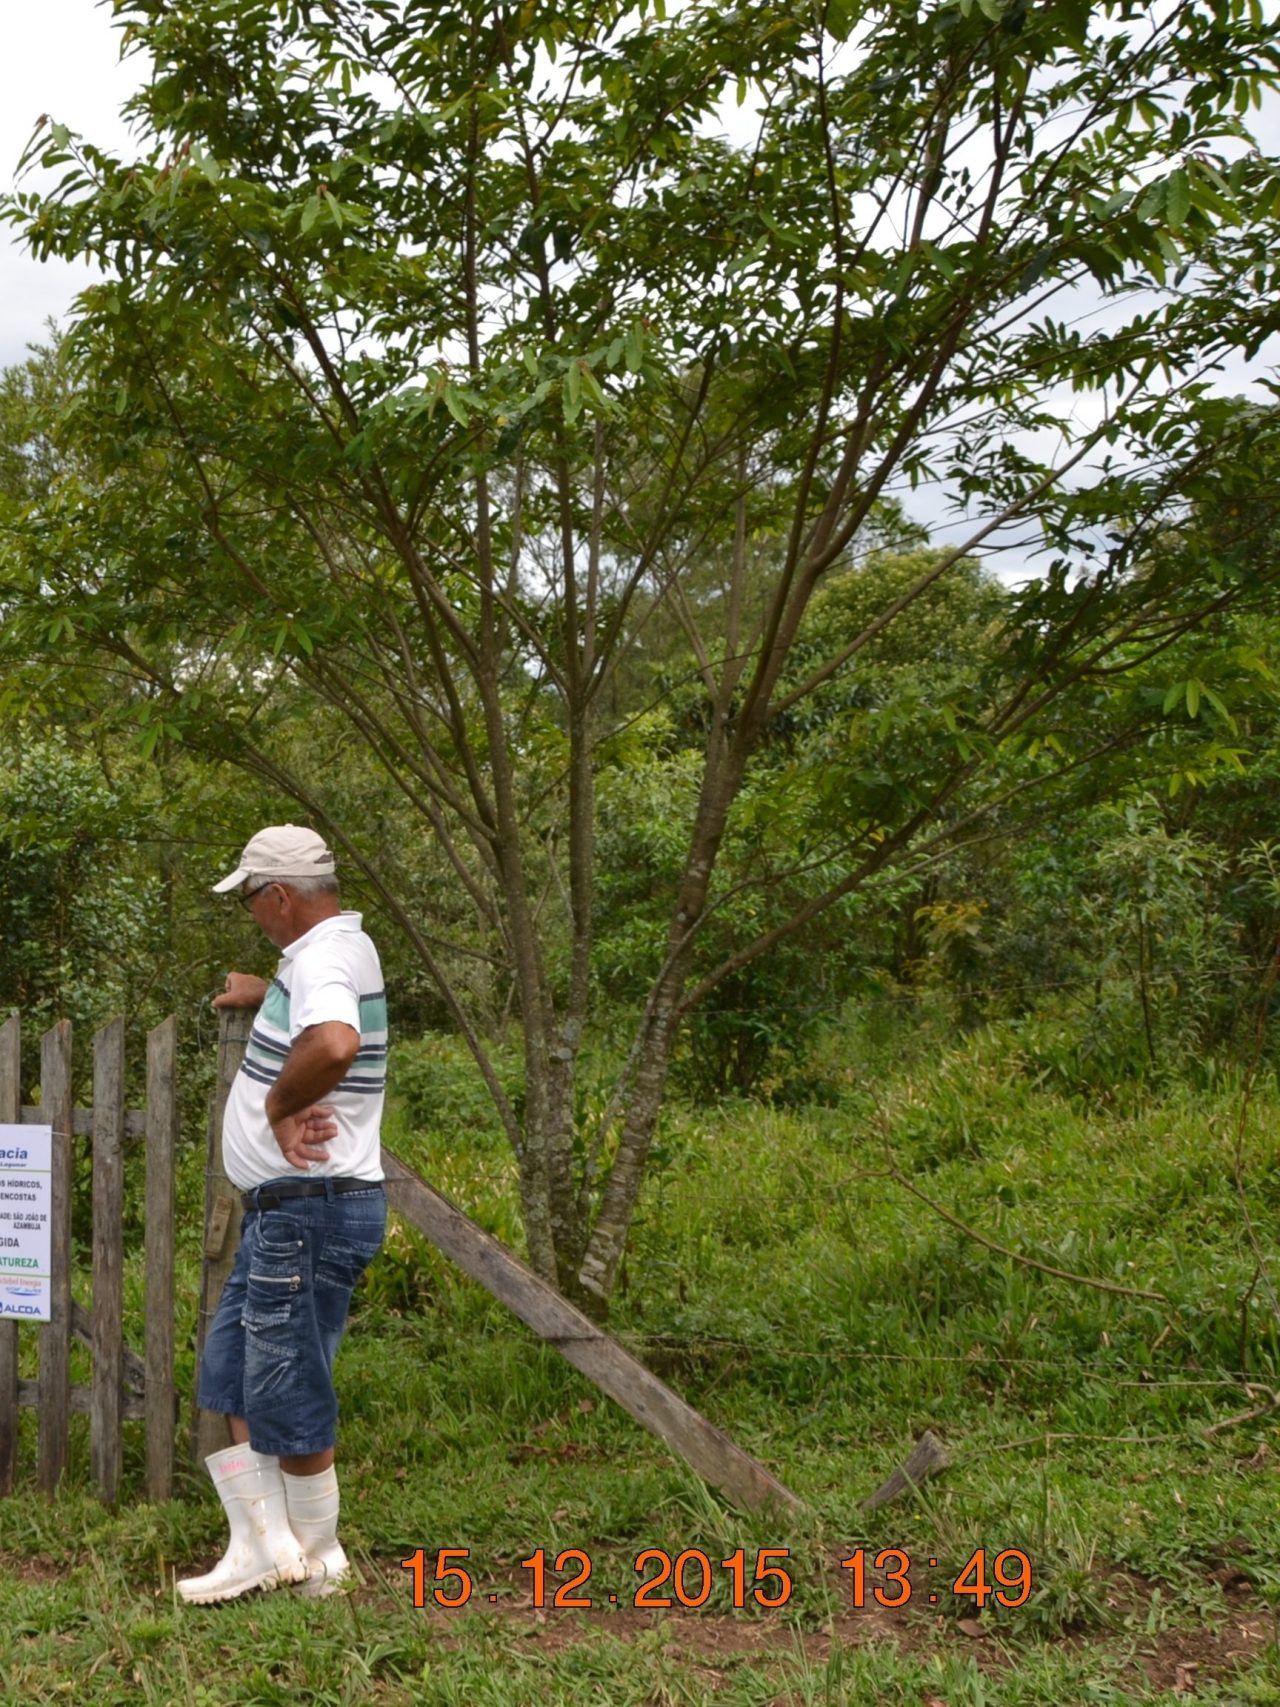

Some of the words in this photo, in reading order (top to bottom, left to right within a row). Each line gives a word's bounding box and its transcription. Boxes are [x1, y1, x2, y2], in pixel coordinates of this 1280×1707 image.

[7, 1179, 42, 1189] HÍDRICOS,
[0, 1193, 36, 1201] ENCOSTAS
[13, 1212, 23, 1220] SÃO
[25, 1213, 39, 1221] JOÃO
[4, 1304, 41, 1314] ALCOA
